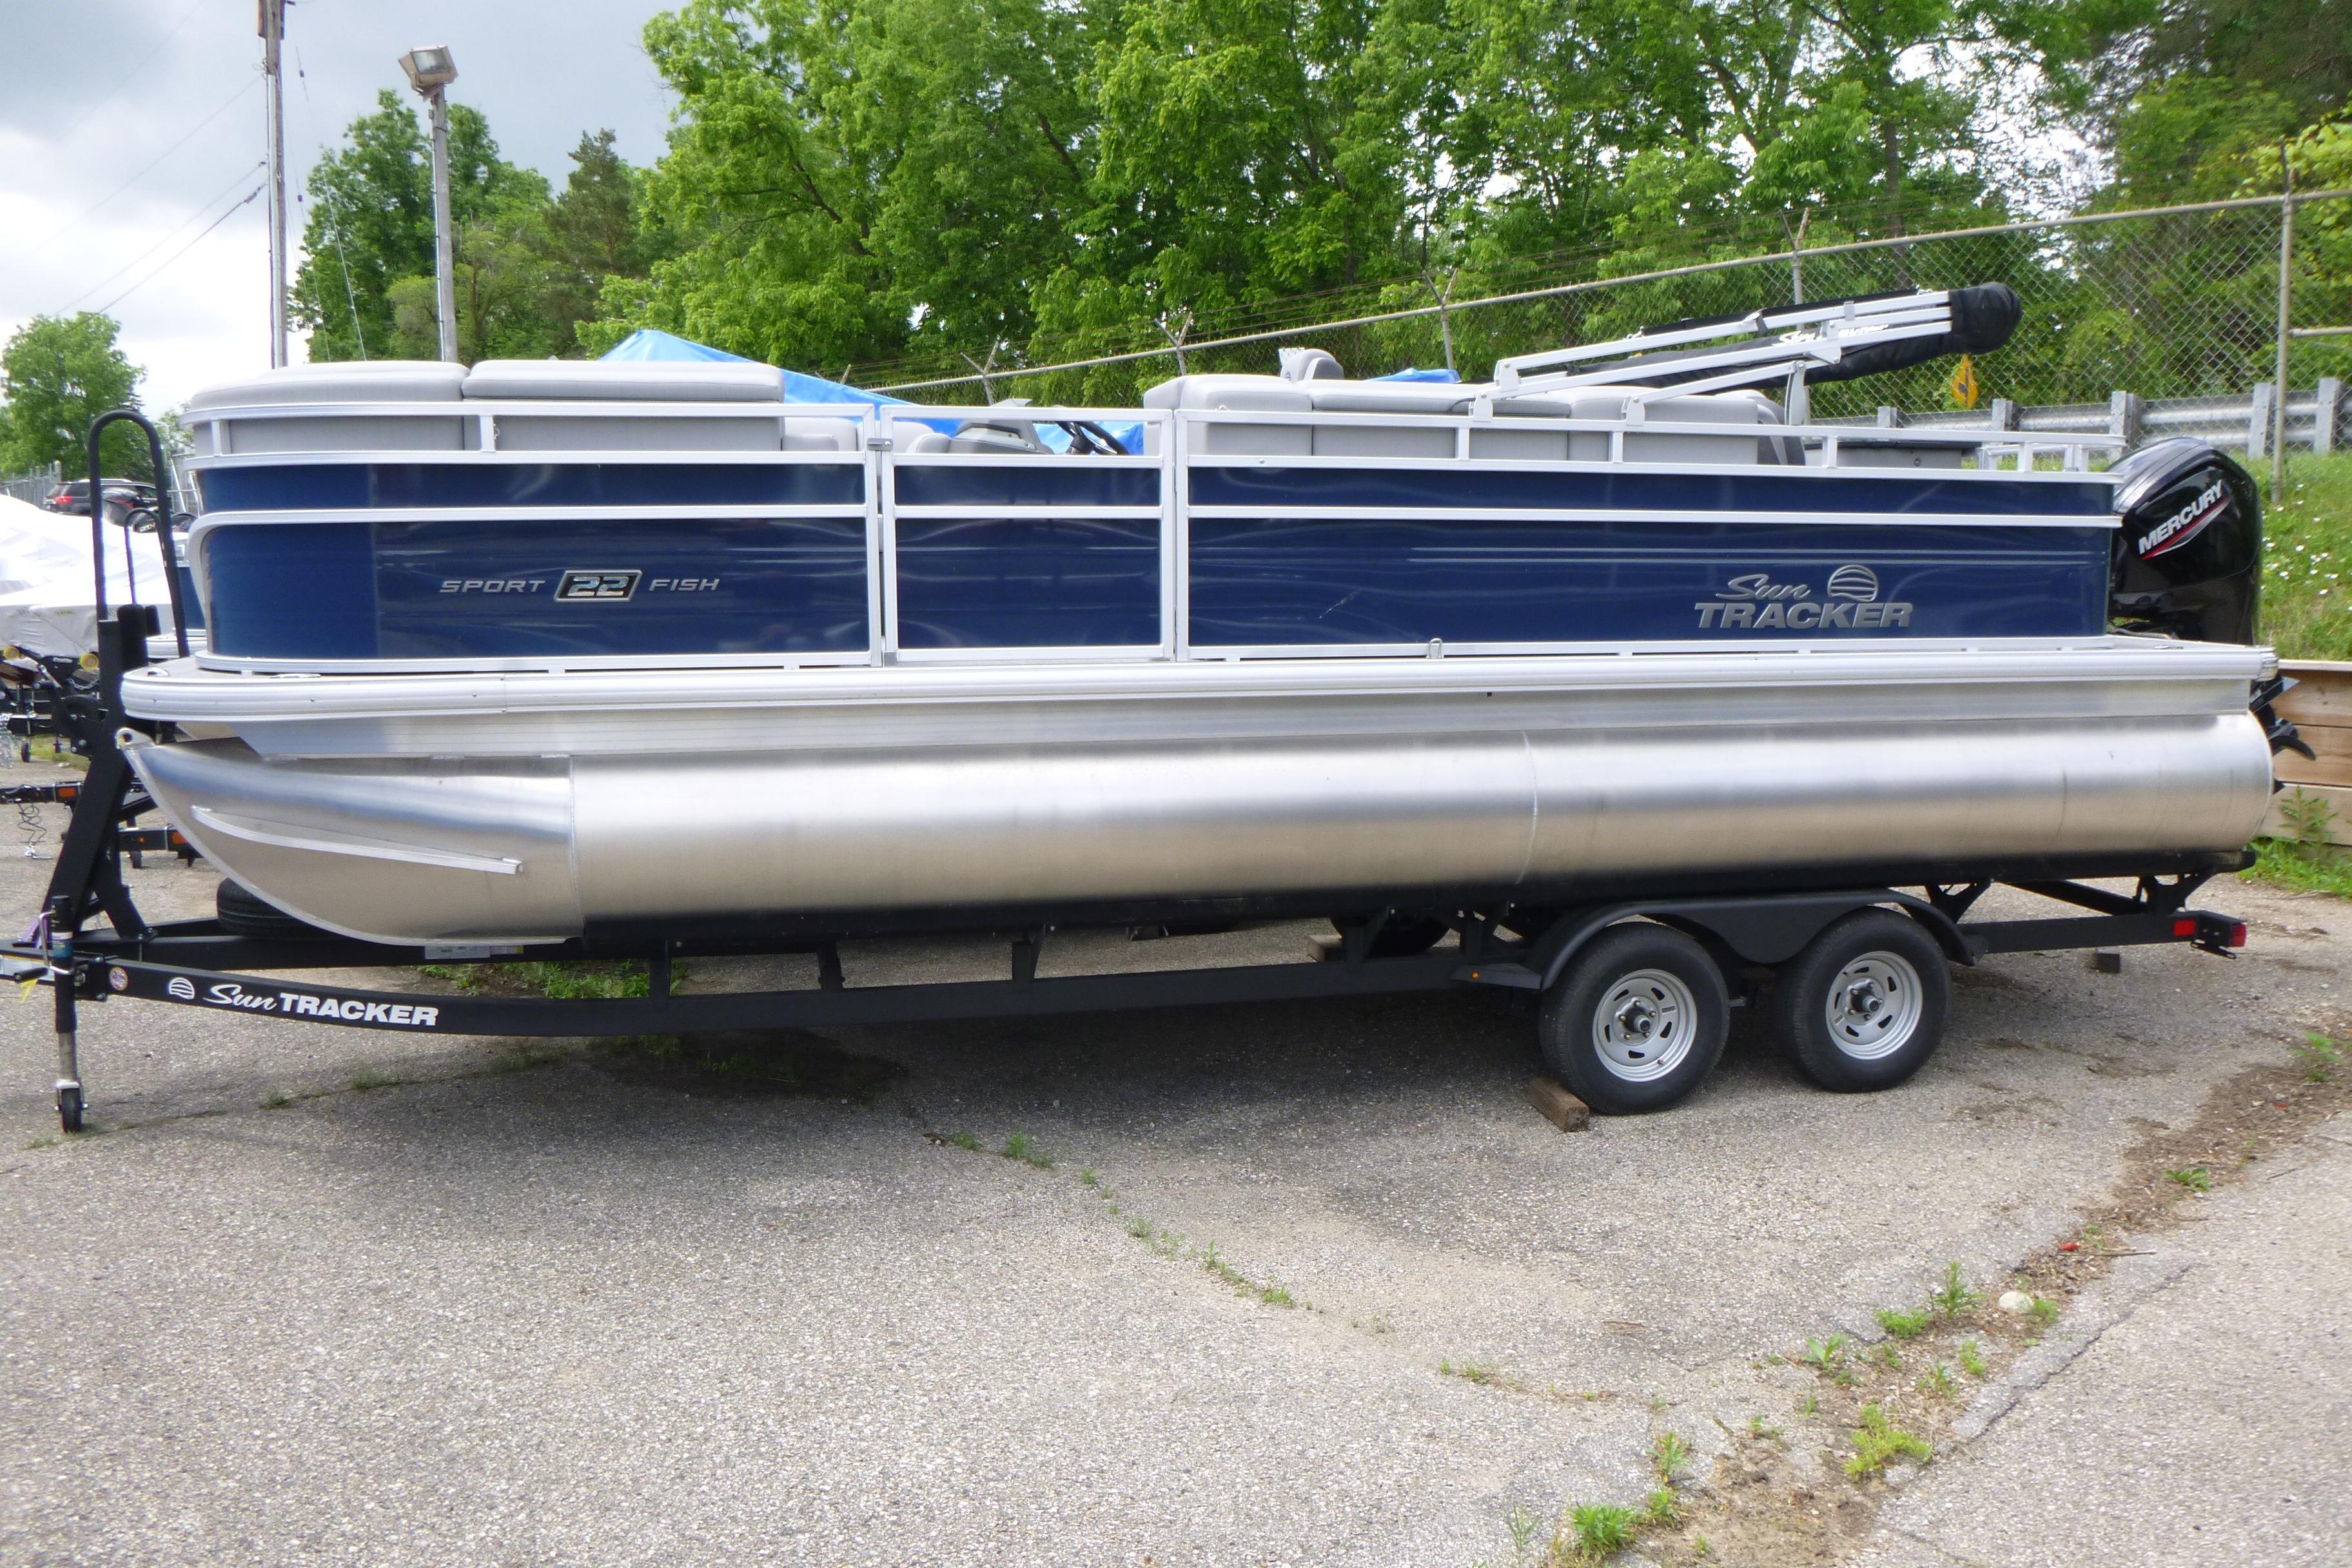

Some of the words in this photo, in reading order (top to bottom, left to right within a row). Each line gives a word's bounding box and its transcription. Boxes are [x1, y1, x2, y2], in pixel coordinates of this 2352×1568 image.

[2138, 479, 2224, 554] MERCURY
[439, 580, 545, 593] SPORT
[567, 576, 630, 597] 22
[649, 578, 720, 592] FISH
[1715, 573, 1811, 601] Sun
[1694, 602, 1914, 629] TRACKER
[202, 984, 277, 1012] Sun
[279, 992, 439, 1027] TRACKER
